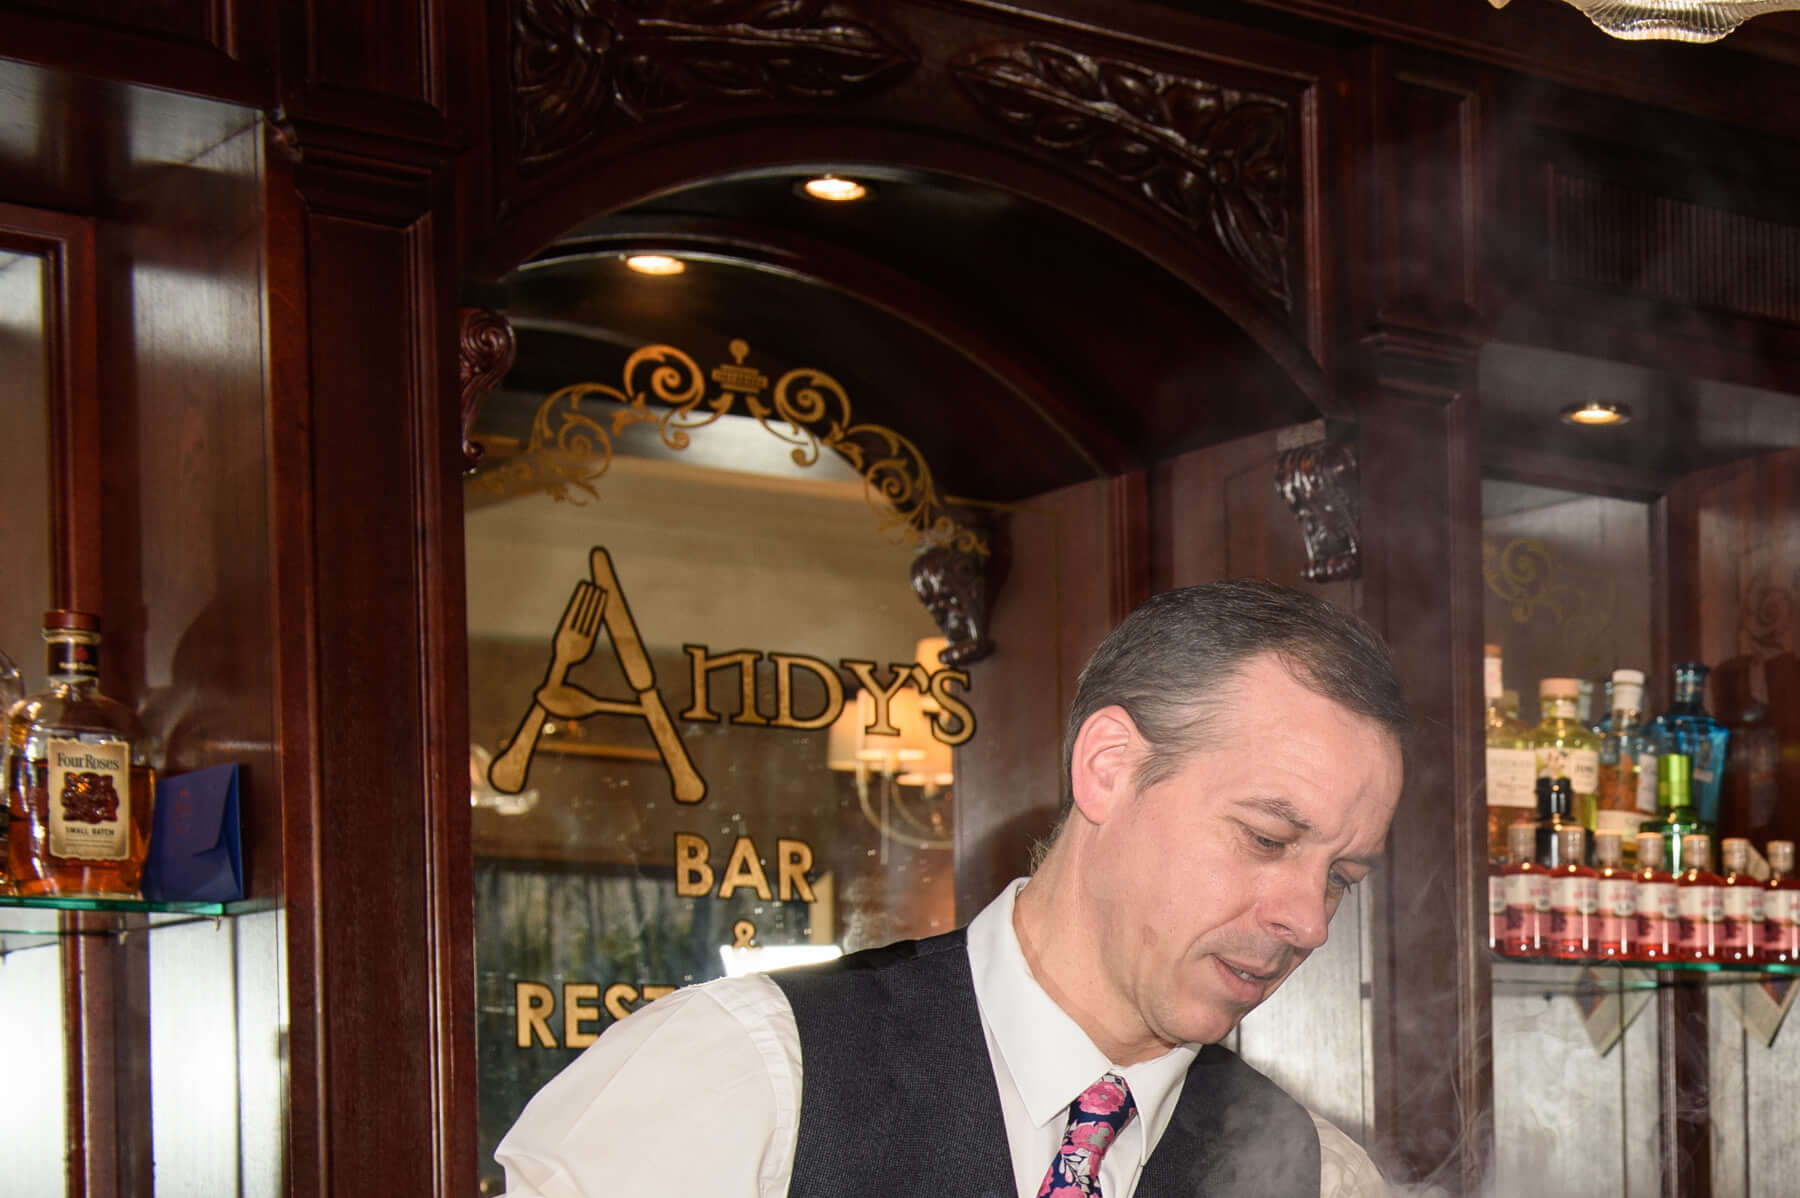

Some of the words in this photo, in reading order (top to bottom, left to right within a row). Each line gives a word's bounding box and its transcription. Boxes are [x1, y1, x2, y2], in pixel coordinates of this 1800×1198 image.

[57, 752, 83, 768] Four
[84, 754, 120, 770] Roses
[674, 831, 817, 903] BAR
[731, 919, 757, 950] &
